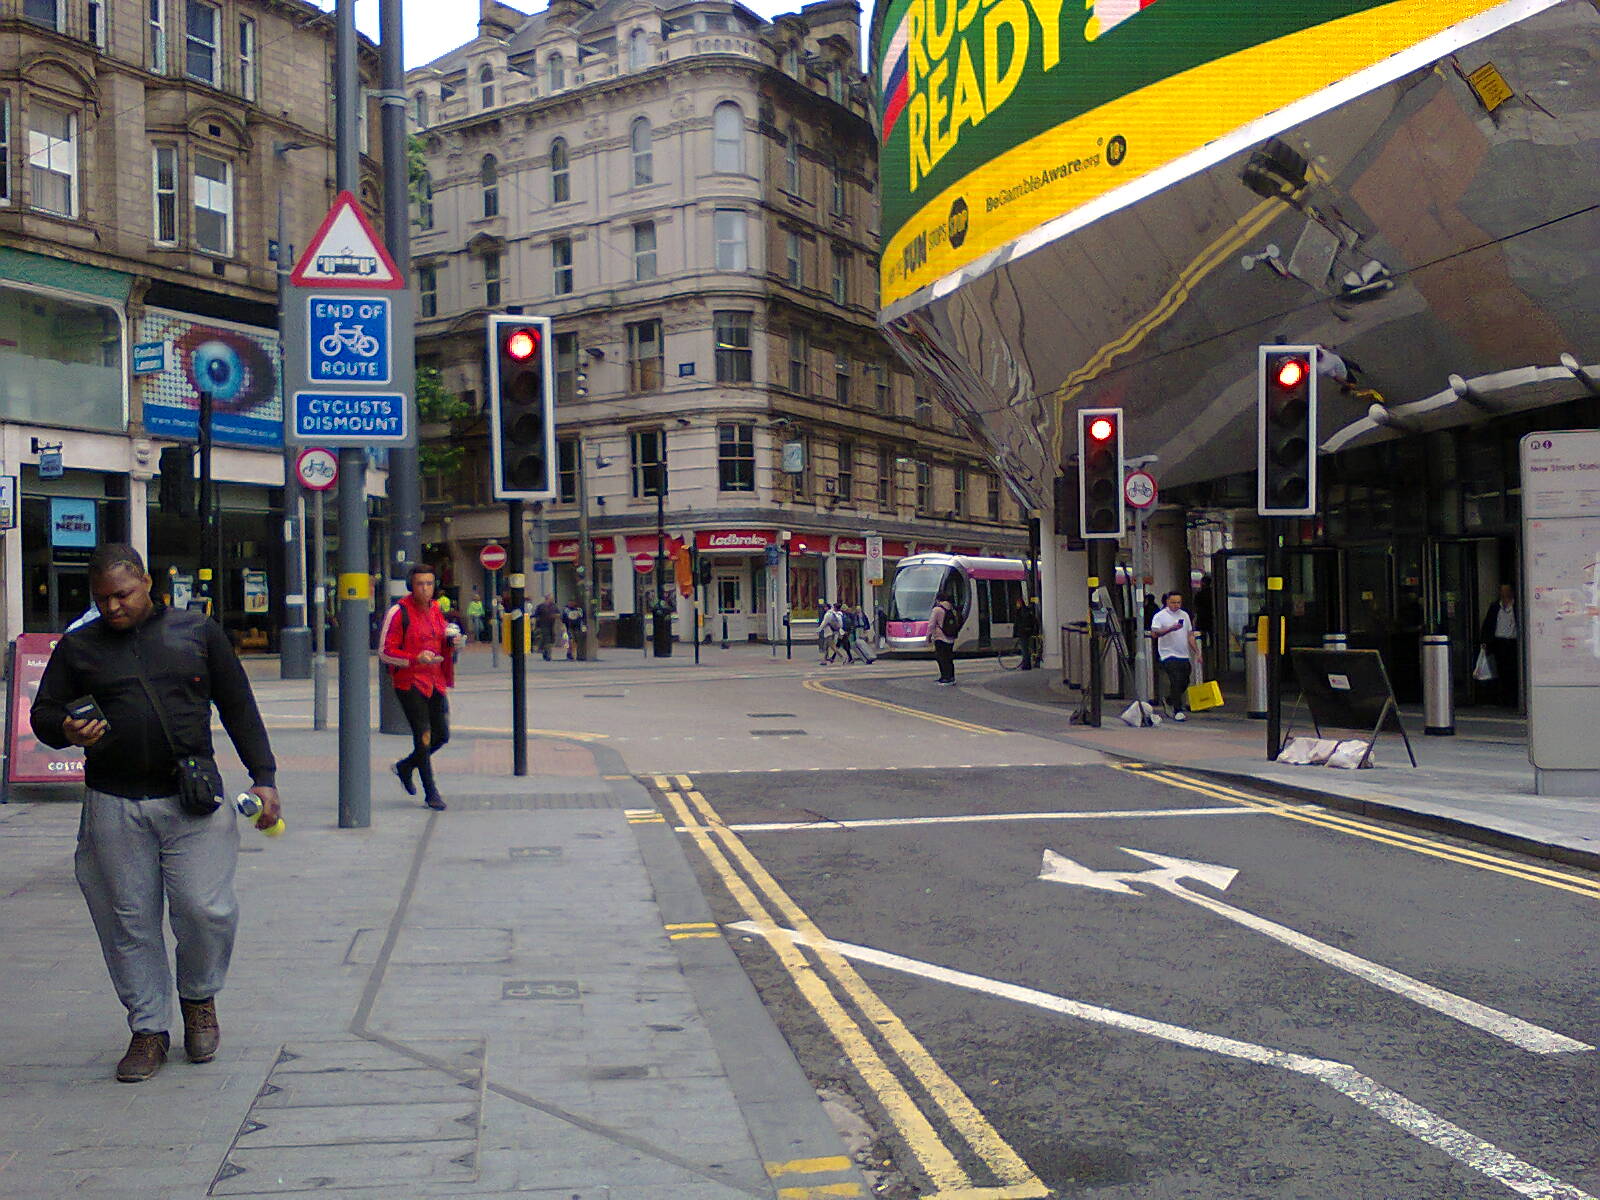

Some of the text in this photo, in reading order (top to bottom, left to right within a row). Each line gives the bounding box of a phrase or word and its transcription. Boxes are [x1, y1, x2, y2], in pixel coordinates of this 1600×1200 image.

[985, 153, 1101, 213] BeGambleAware.org
[315, 303, 383, 319] END OF
[320, 360, 379, 376] ROUTE
[308, 399, 392, 415] CYCLISTS
[302, 416, 399, 431] DISMOUNT
[709, 533, 768, 546] Ladbrokes
[47, 761, 84, 771] COSTA
